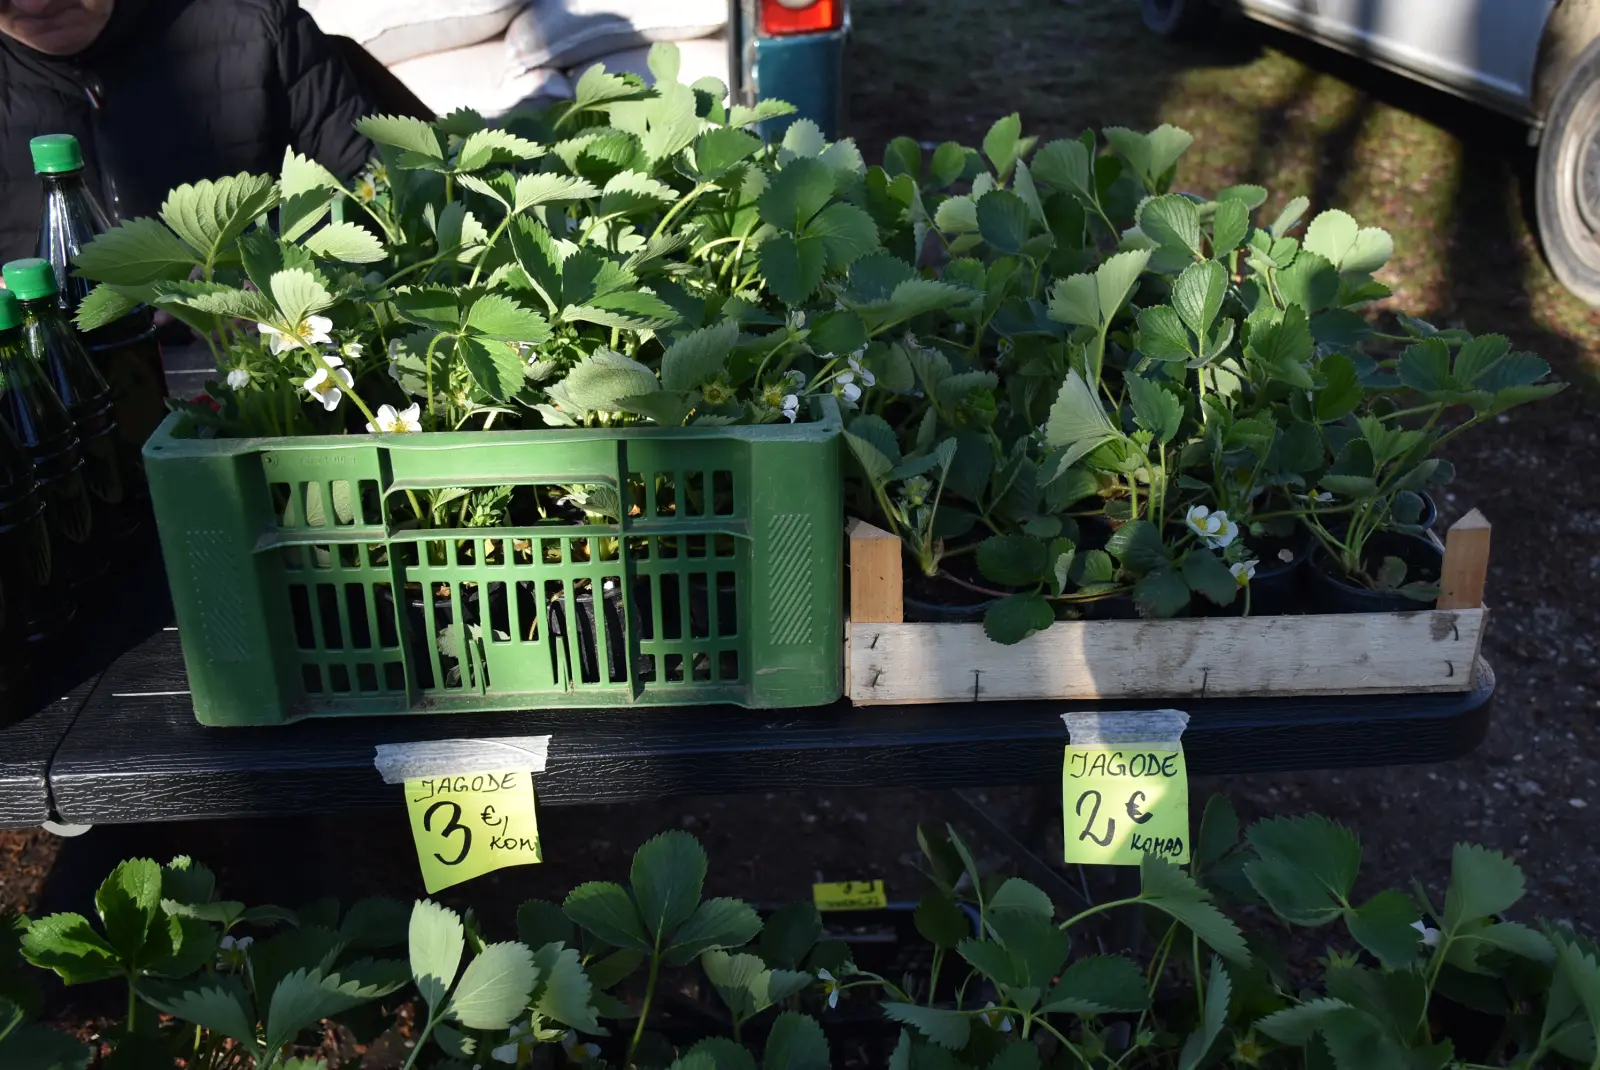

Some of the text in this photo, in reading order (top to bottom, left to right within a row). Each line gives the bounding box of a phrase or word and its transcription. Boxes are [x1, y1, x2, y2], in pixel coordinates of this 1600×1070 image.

[1070, 752, 1179, 778] JAGODE
[413, 771, 518, 803] JAGODE
[423, 800, 472, 866] 3
[1076, 789, 1154, 847] 2 €
[1130, 833, 1184, 857] KOMAD
